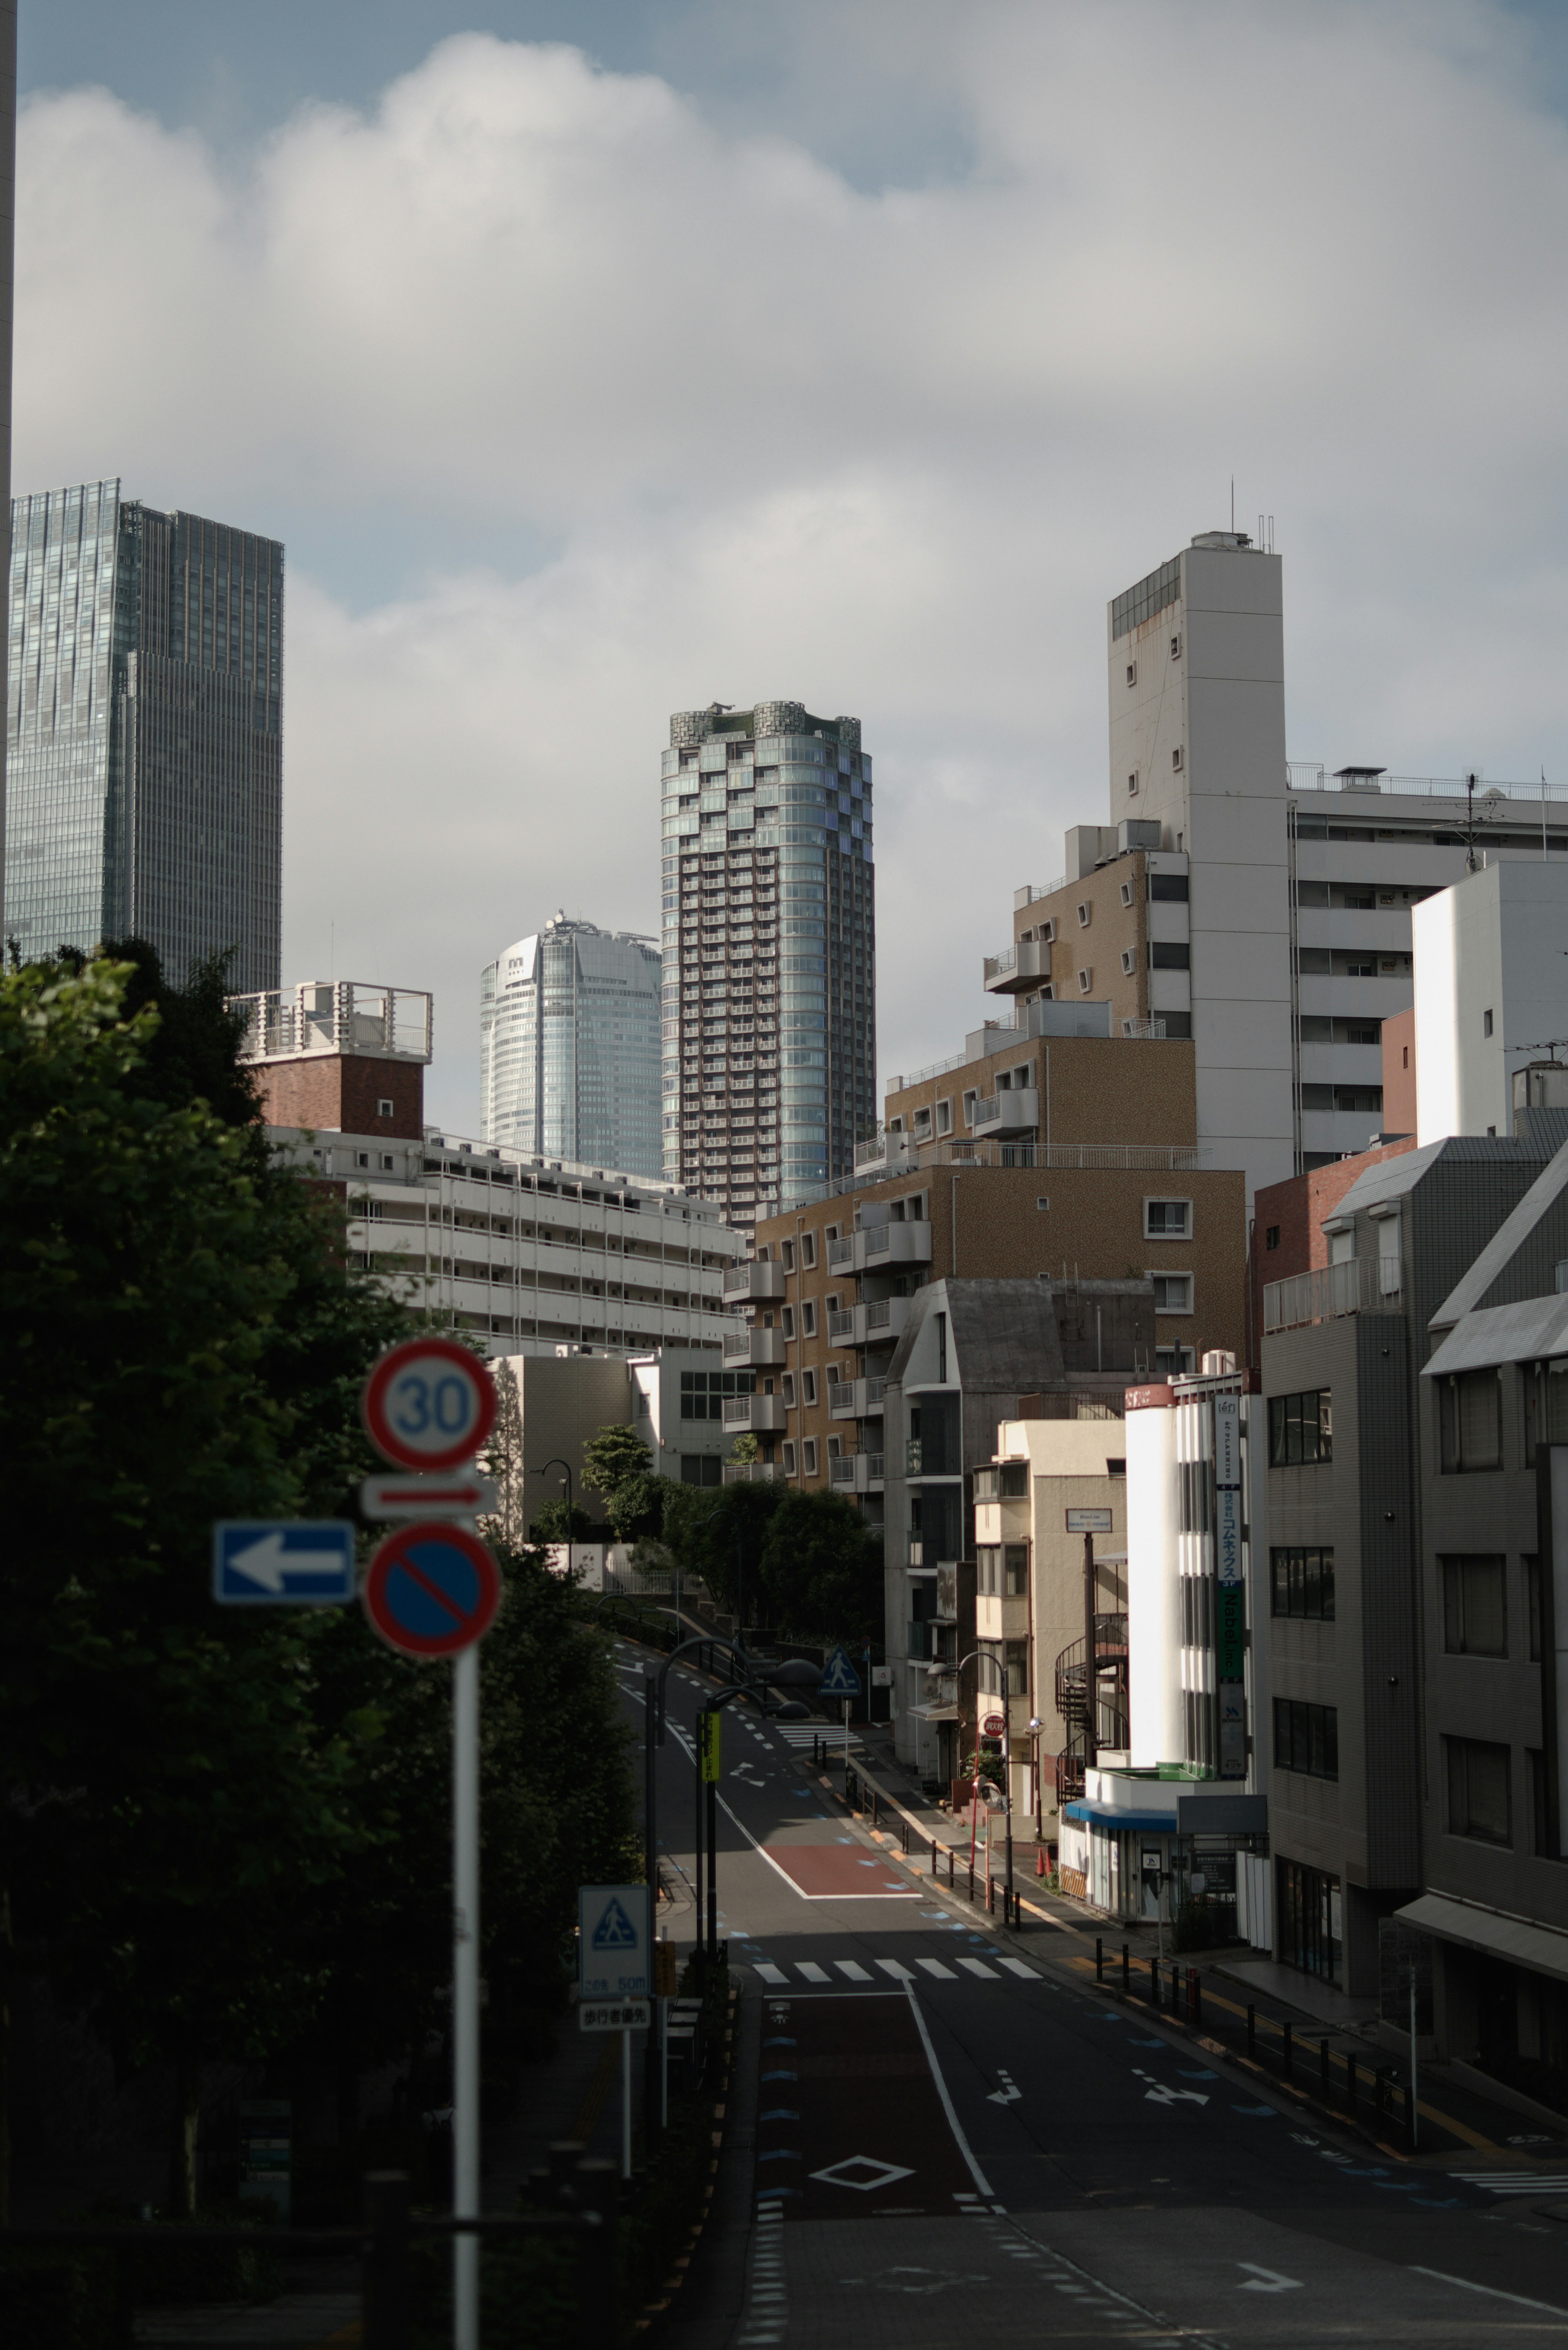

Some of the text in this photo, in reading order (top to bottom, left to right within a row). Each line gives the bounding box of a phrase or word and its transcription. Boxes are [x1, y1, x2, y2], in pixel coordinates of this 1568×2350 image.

[396, 1376, 470, 1434] 30
[986, 1721, 1004, 1731] 消火栓
[619, 1977, 646, 1991] 50m
[585, 2007, 646, 2026] 歩行者優先
